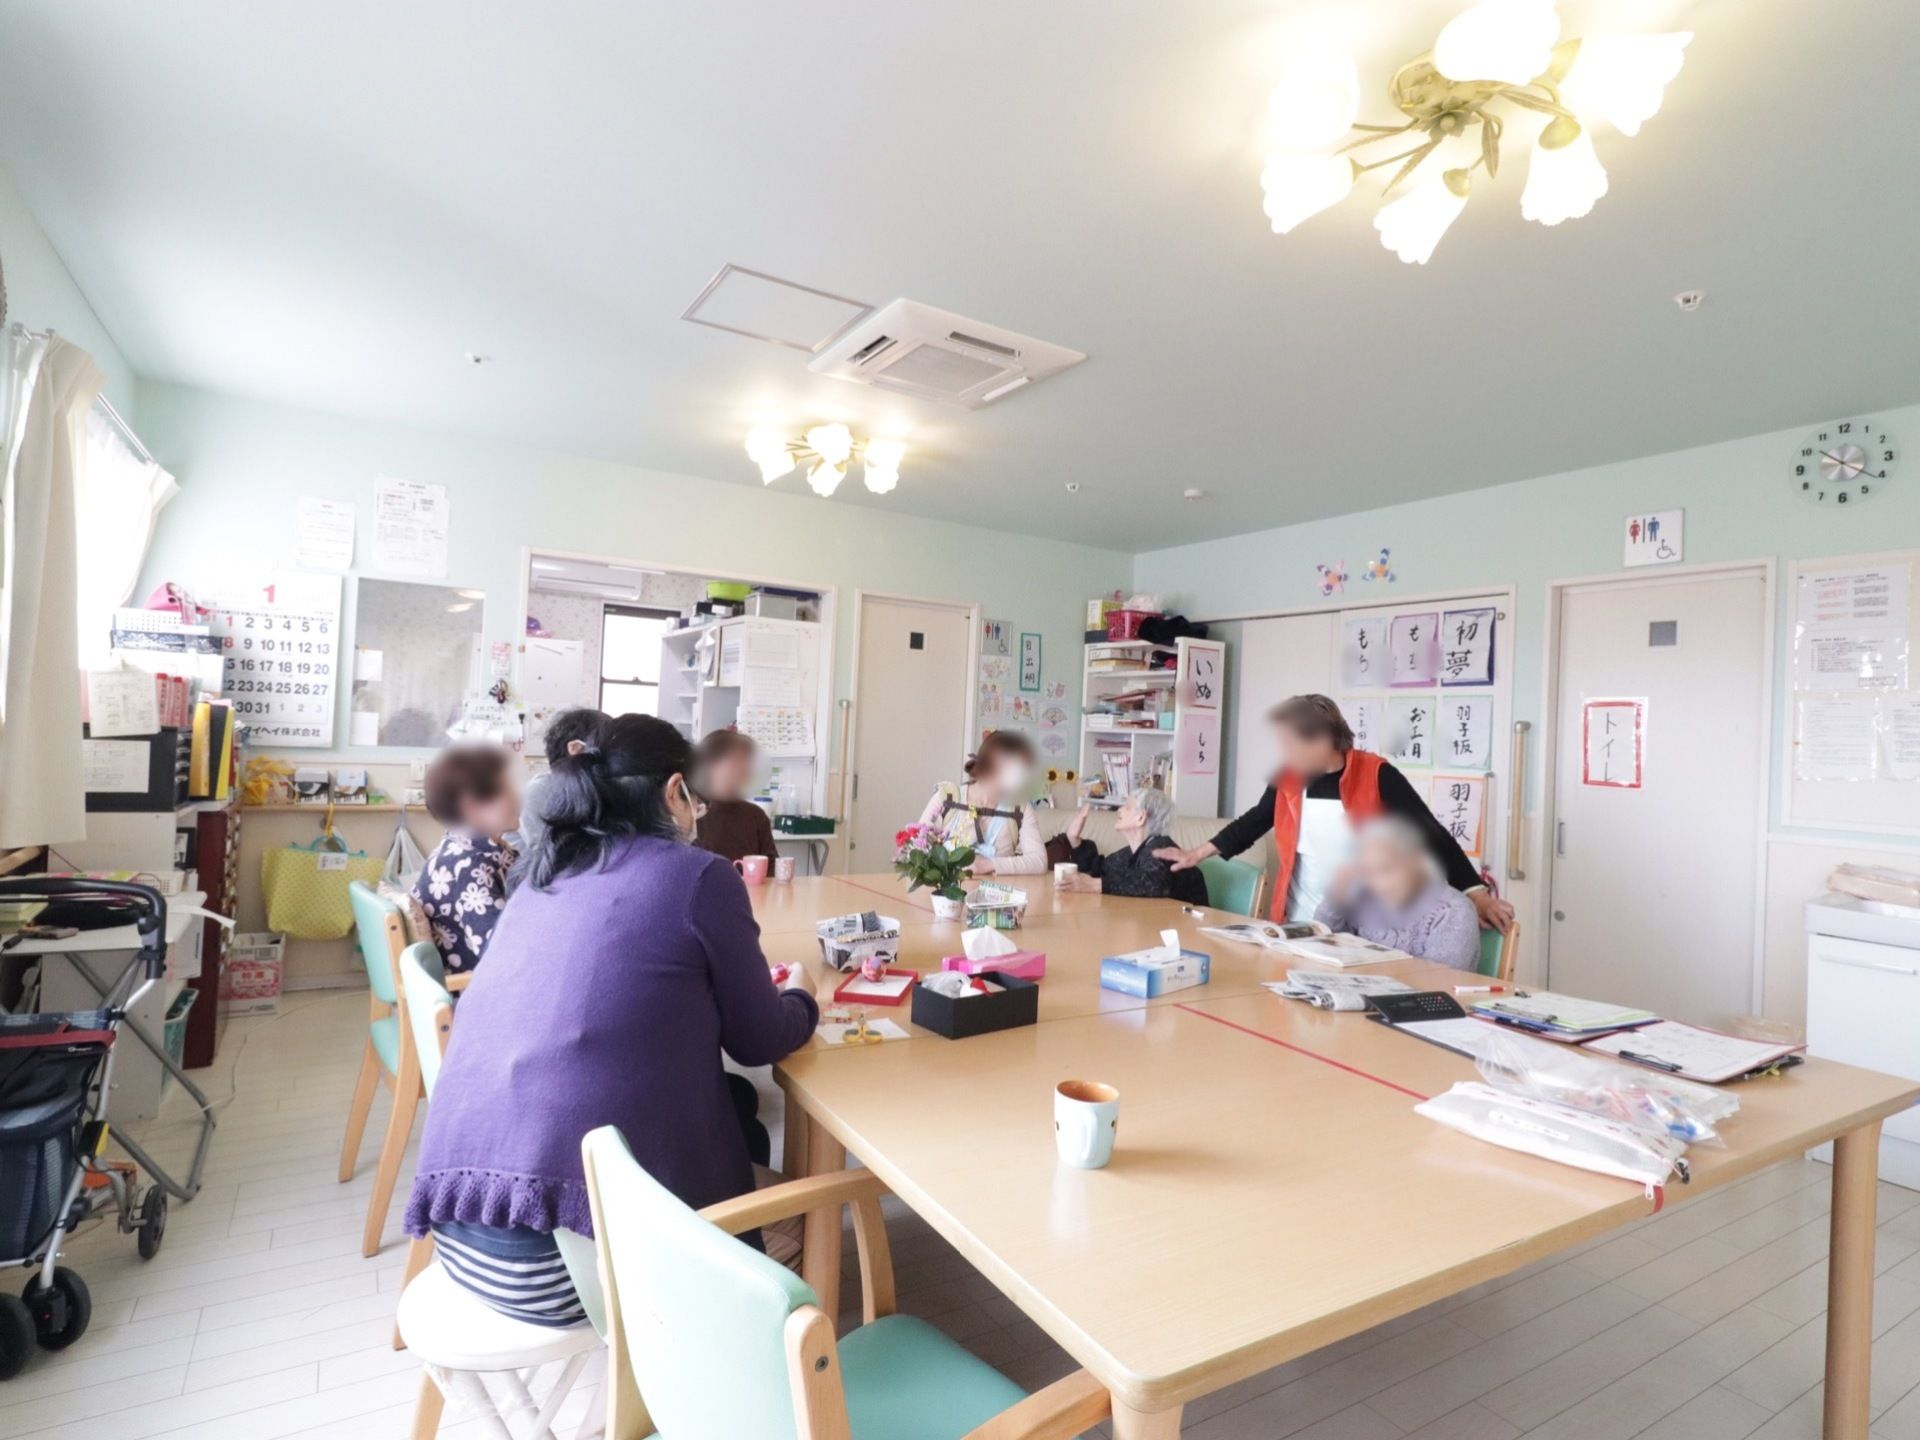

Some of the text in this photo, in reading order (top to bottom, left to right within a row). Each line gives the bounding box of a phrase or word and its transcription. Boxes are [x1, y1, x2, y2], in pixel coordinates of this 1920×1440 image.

[1838, 423, 1851, 434] 12
[1865, 425, 1869, 433] 1
[1819, 433, 1827, 441] 11
[1880, 435, 1886, 444] 2
[1801, 448, 1812, 457] 10
[1884, 450, 1894, 461] 3
[1796, 465, 1805, 476] 9
[1878, 470, 1886, 478] 4
[1802, 482, 1809, 490] 8
[1861, 485, 1869, 494] 5
[1818, 492, 1824, 501] 7
[1838, 492, 1847, 503] 6
[263, 584, 276, 603] 1
[226, 616, 233, 628] 1
[245, 617, 255, 629] 2
[264, 618, 273, 630] 3
[283, 620, 291, 631] 4
[301, 621, 310, 632] 5
[320, 623, 328, 634] 6
[224, 636, 330, 654] 8 9 10 11 12 13
[1445, 620, 1478, 680] 初夢
[240, 659, 255, 671] 16
[260, 660, 274, 672] 17
[278, 661, 292, 673] 18
[297, 663, 311, 674] 19
[314, 663, 330, 675] 20
[237, 680, 254, 692] 23
[256, 681, 273, 693] 24
[275, 682, 291, 694] 25
[294, 683, 310, 695] 26
[312, 684, 329, 696] 27
[236, 702, 253, 713] 30
[255, 702, 270, 714] 31
[298, 704, 304, 712] 2
[1453, 705, 1473, 755] 羽子板
[1600, 711, 1618, 783] トイレ
[1450, 783, 1471, 841] 羽子板
